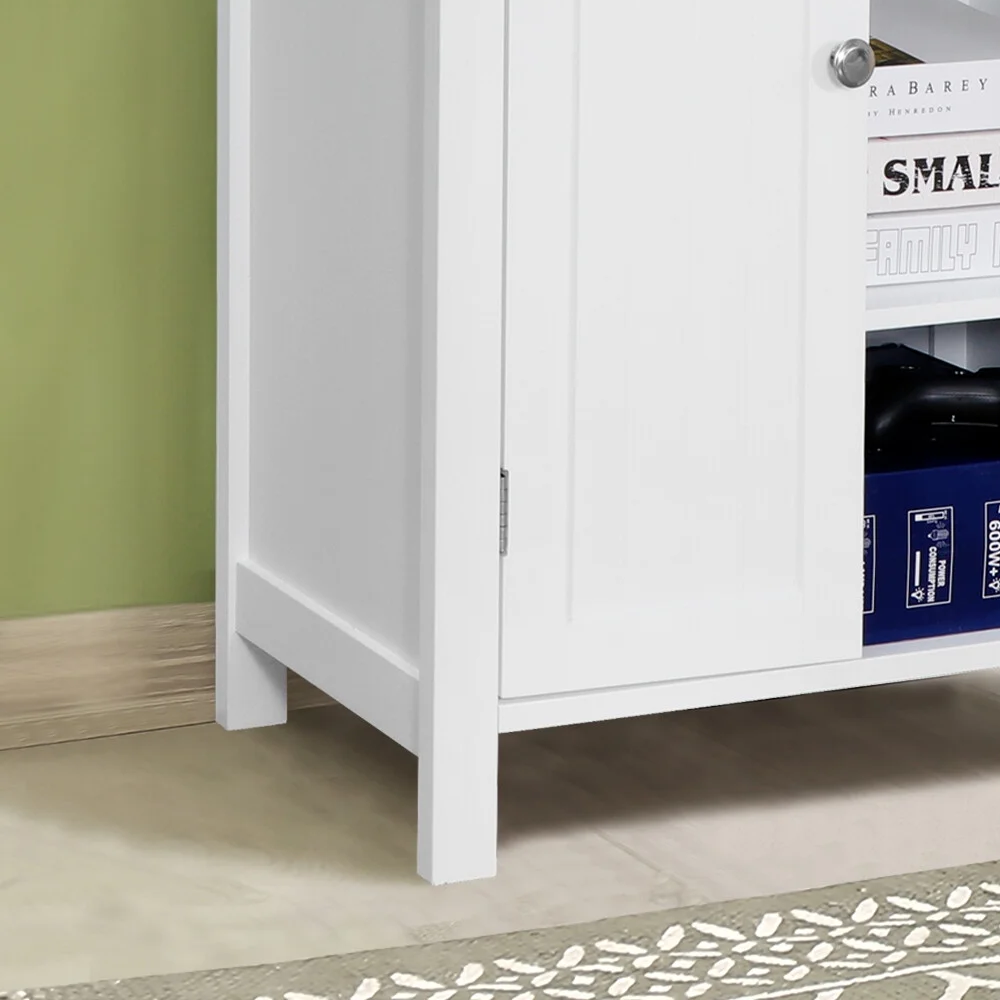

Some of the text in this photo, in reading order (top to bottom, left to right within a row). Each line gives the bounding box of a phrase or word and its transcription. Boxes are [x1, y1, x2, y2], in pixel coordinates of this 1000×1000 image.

[908, 78, 989, 95] BAREY
[927, 546, 938, 603] CONSUMPTION
[937, 559, 947, 588] POWER
